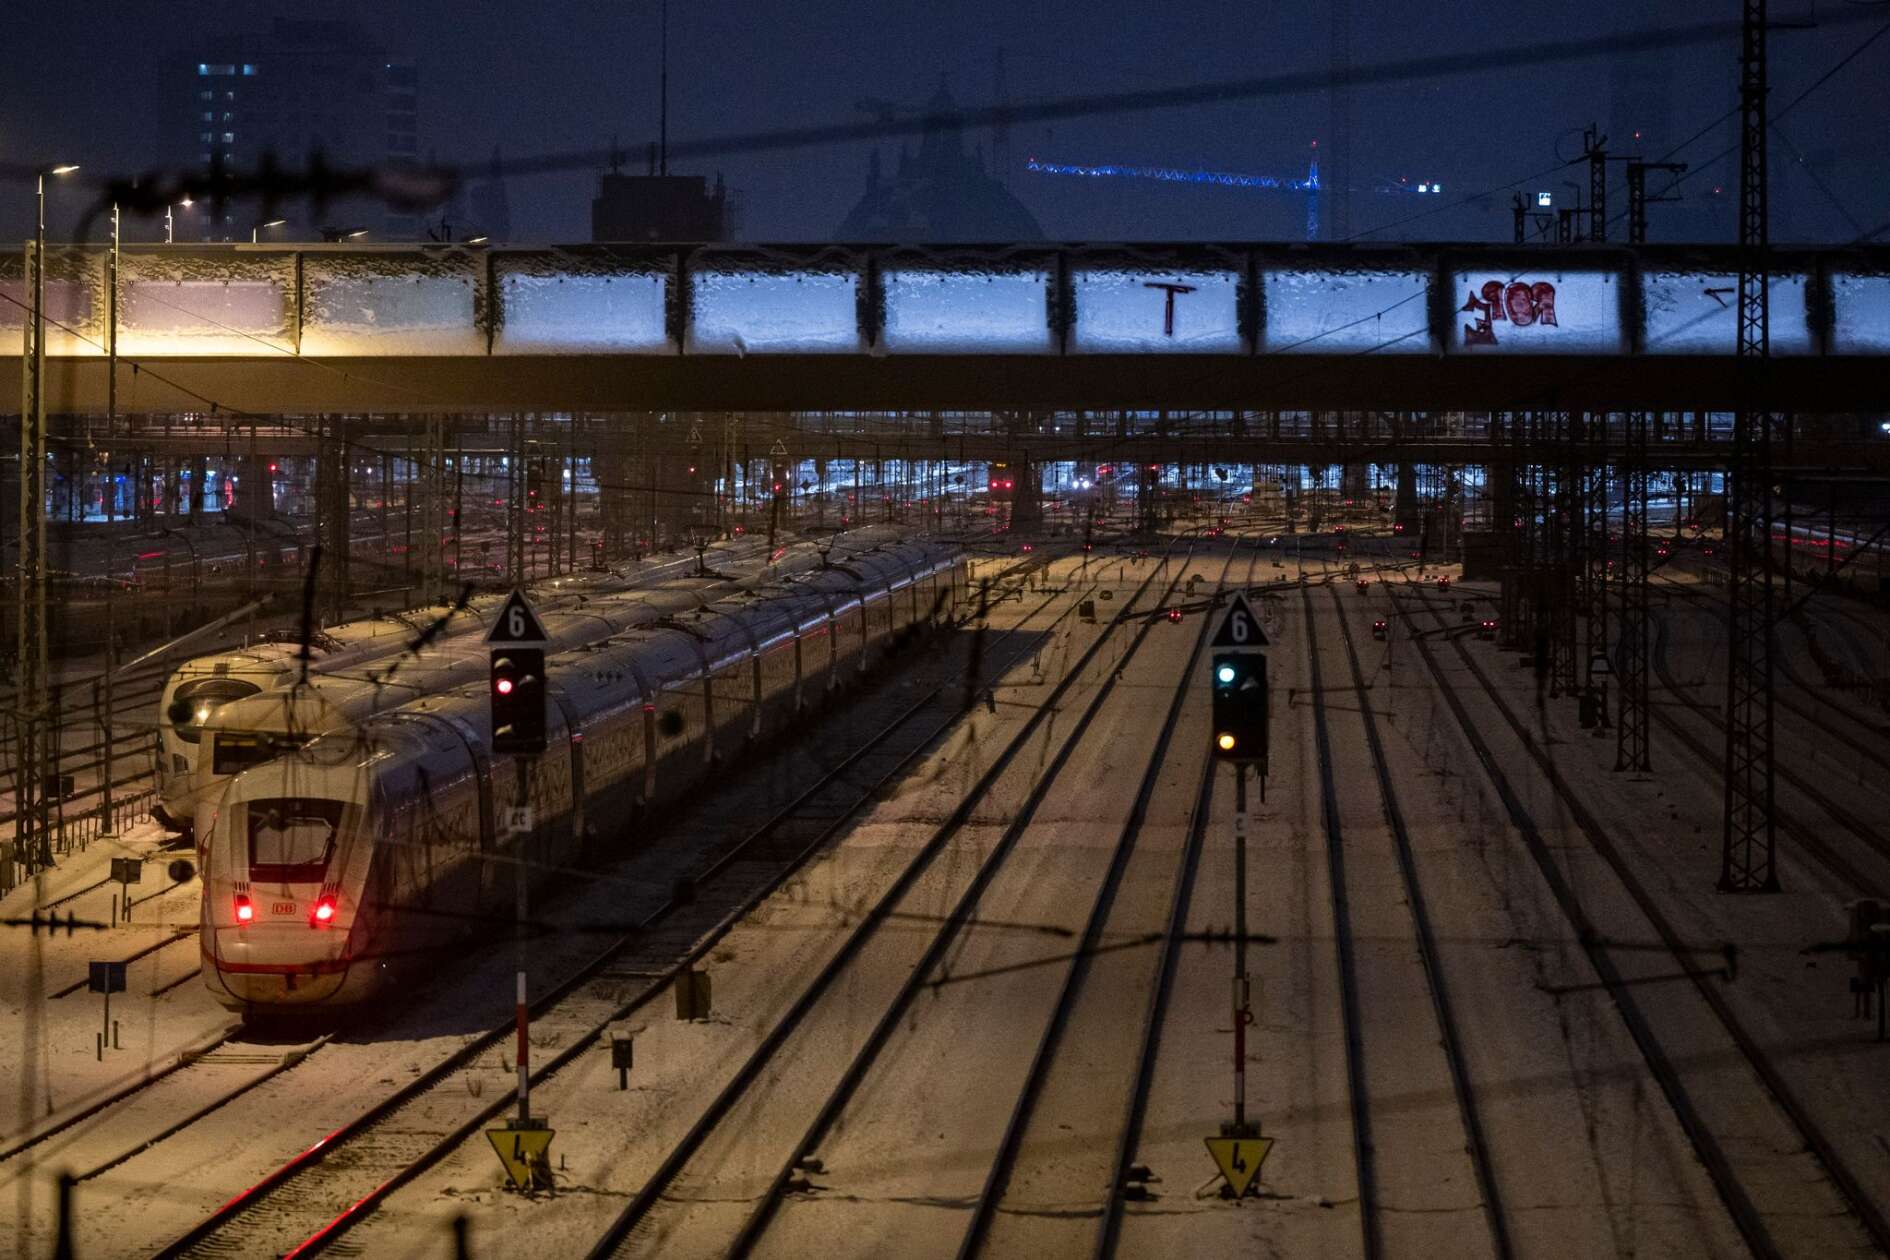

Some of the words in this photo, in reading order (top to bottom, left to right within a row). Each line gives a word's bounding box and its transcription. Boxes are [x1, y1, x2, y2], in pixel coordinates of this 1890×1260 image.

[508, 604, 525, 638] 6
[1231, 609, 1249, 643] 6
[274, 903, 294, 913] DB
[1231, 1142, 1247, 1174] 4
